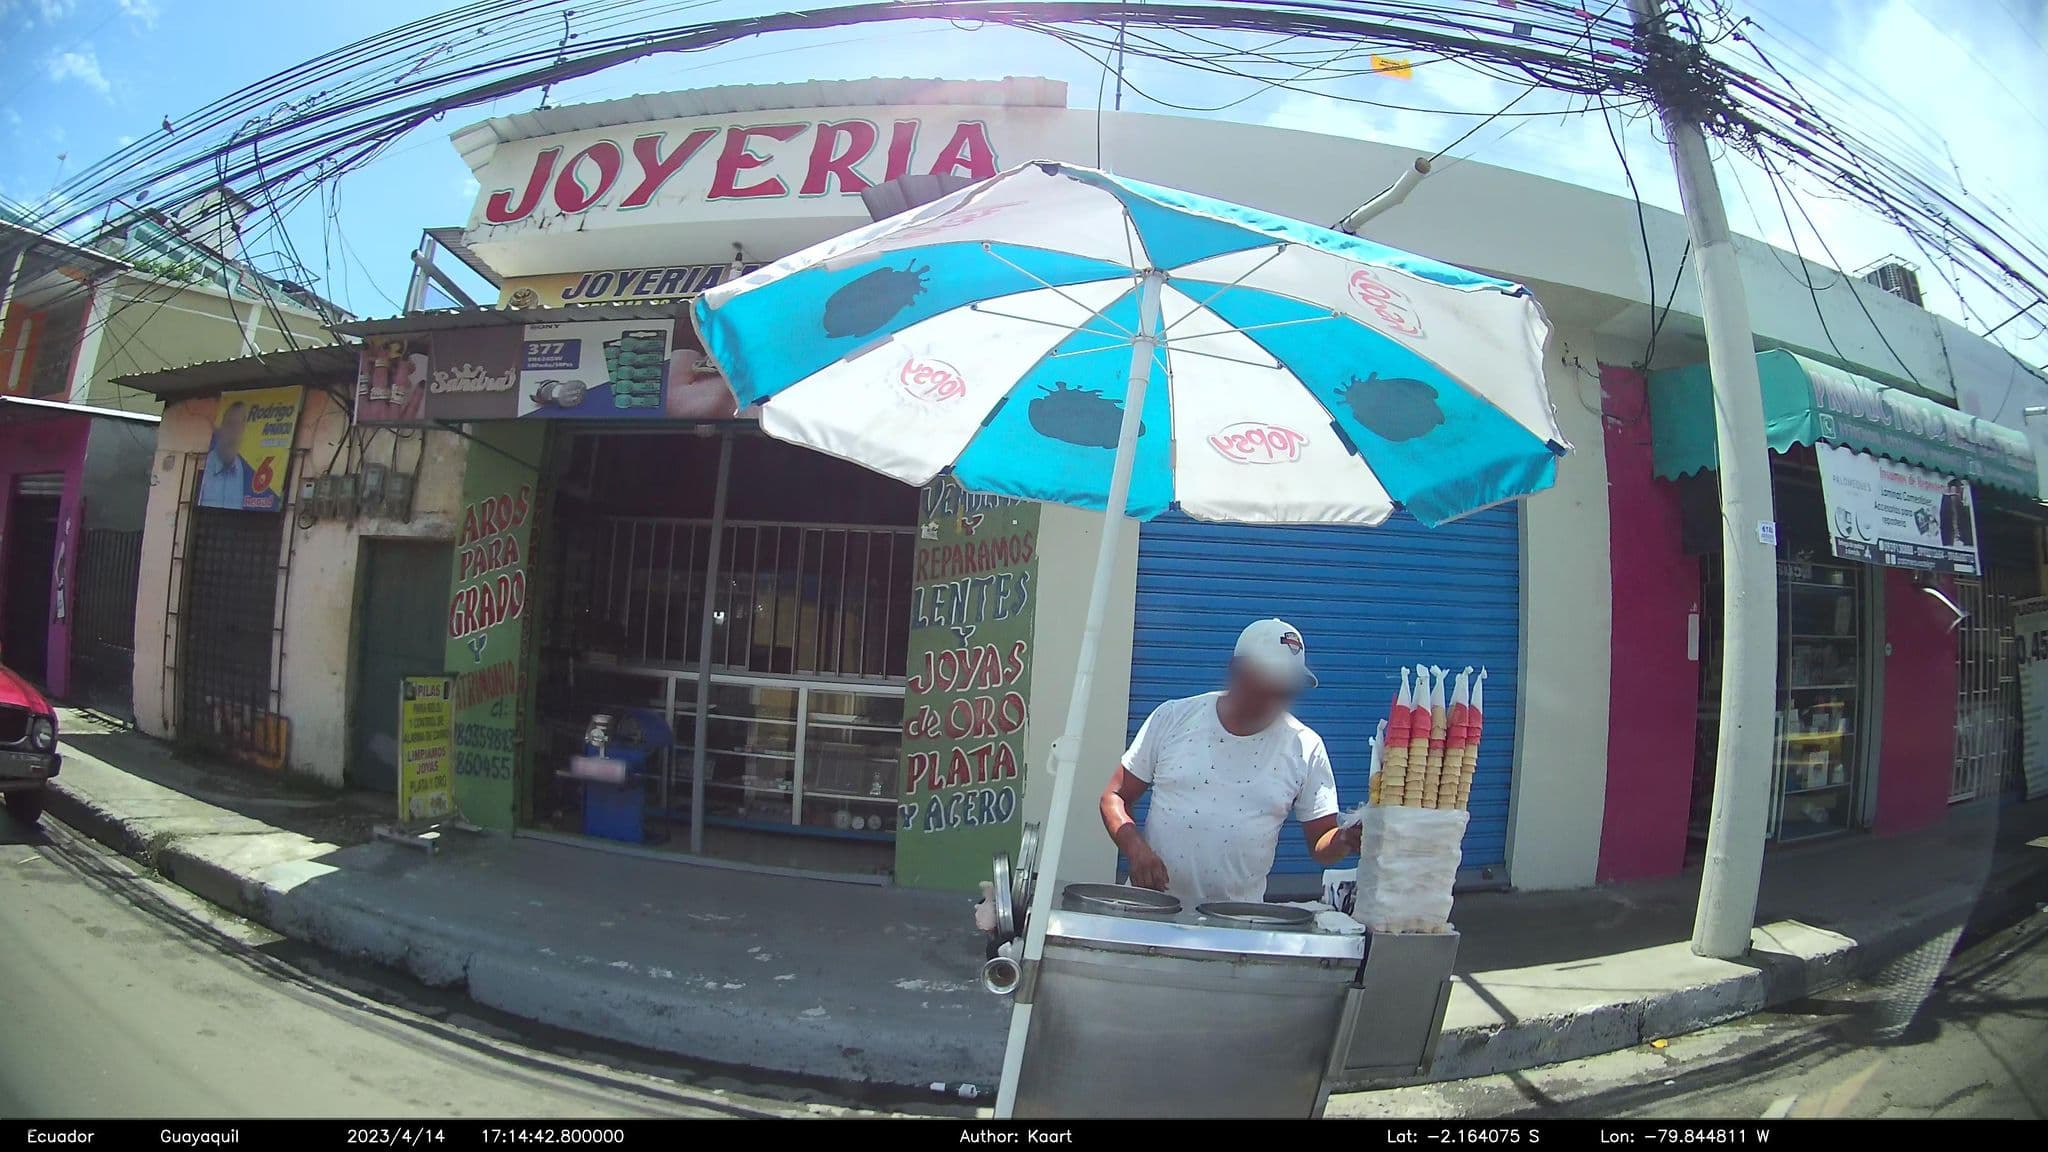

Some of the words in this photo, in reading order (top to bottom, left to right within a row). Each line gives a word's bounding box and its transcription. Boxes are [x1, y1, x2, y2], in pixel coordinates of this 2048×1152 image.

[485, 119, 1000, 225] JOYERIA
[561, 264, 726, 301] JOYERIA
[527, 342, 565, 355] 377
[247, 402, 294, 422] Rodrigo
[252, 456, 275, 494] 6
[457, 484, 530, 548] AROS
[961, 514, 984, 535] Y
[458, 533, 520, 582] PARA
[916, 530, 1034, 582] REPARAMOS
[449, 569, 526, 640] GRADO
[911, 571, 1031, 630] LENTES
[467, 633, 488, 664] Y
[951, 625, 977, 647] Y
[907, 640, 1028, 694] JOYAS
[416, 683, 441, 697] PILAS
[904, 705, 942, 740] de
[945, 691, 1027, 740] ORO
[906, 741, 1018, 795] PLATA
[898, 803, 919, 830] Y
